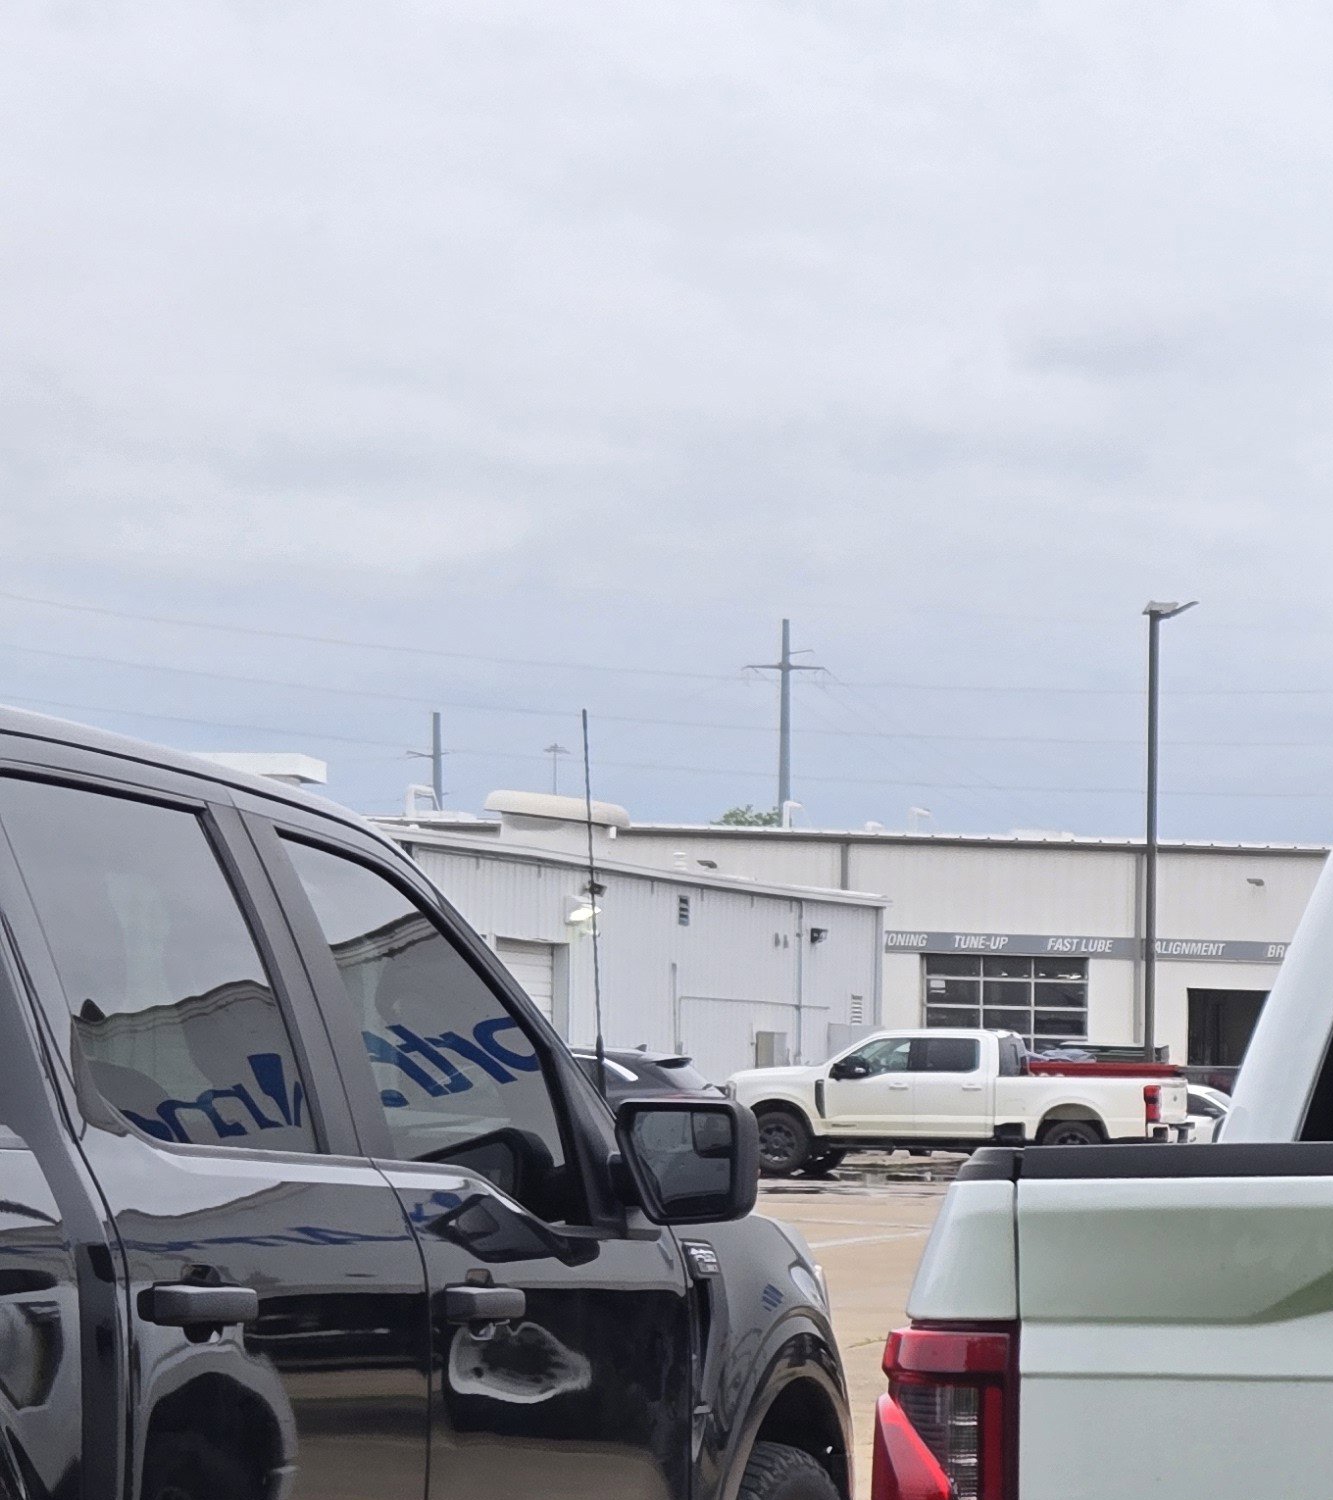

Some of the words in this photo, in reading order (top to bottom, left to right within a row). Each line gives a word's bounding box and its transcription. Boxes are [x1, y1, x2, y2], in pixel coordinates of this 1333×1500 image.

[954, 935, 1008, 950] TUNE-UP
[1047, 938, 1079, 951] FAST
[1081, 939, 1114, 952] LUBE
[1155, 941, 1225, 957] ALIGNMENT
